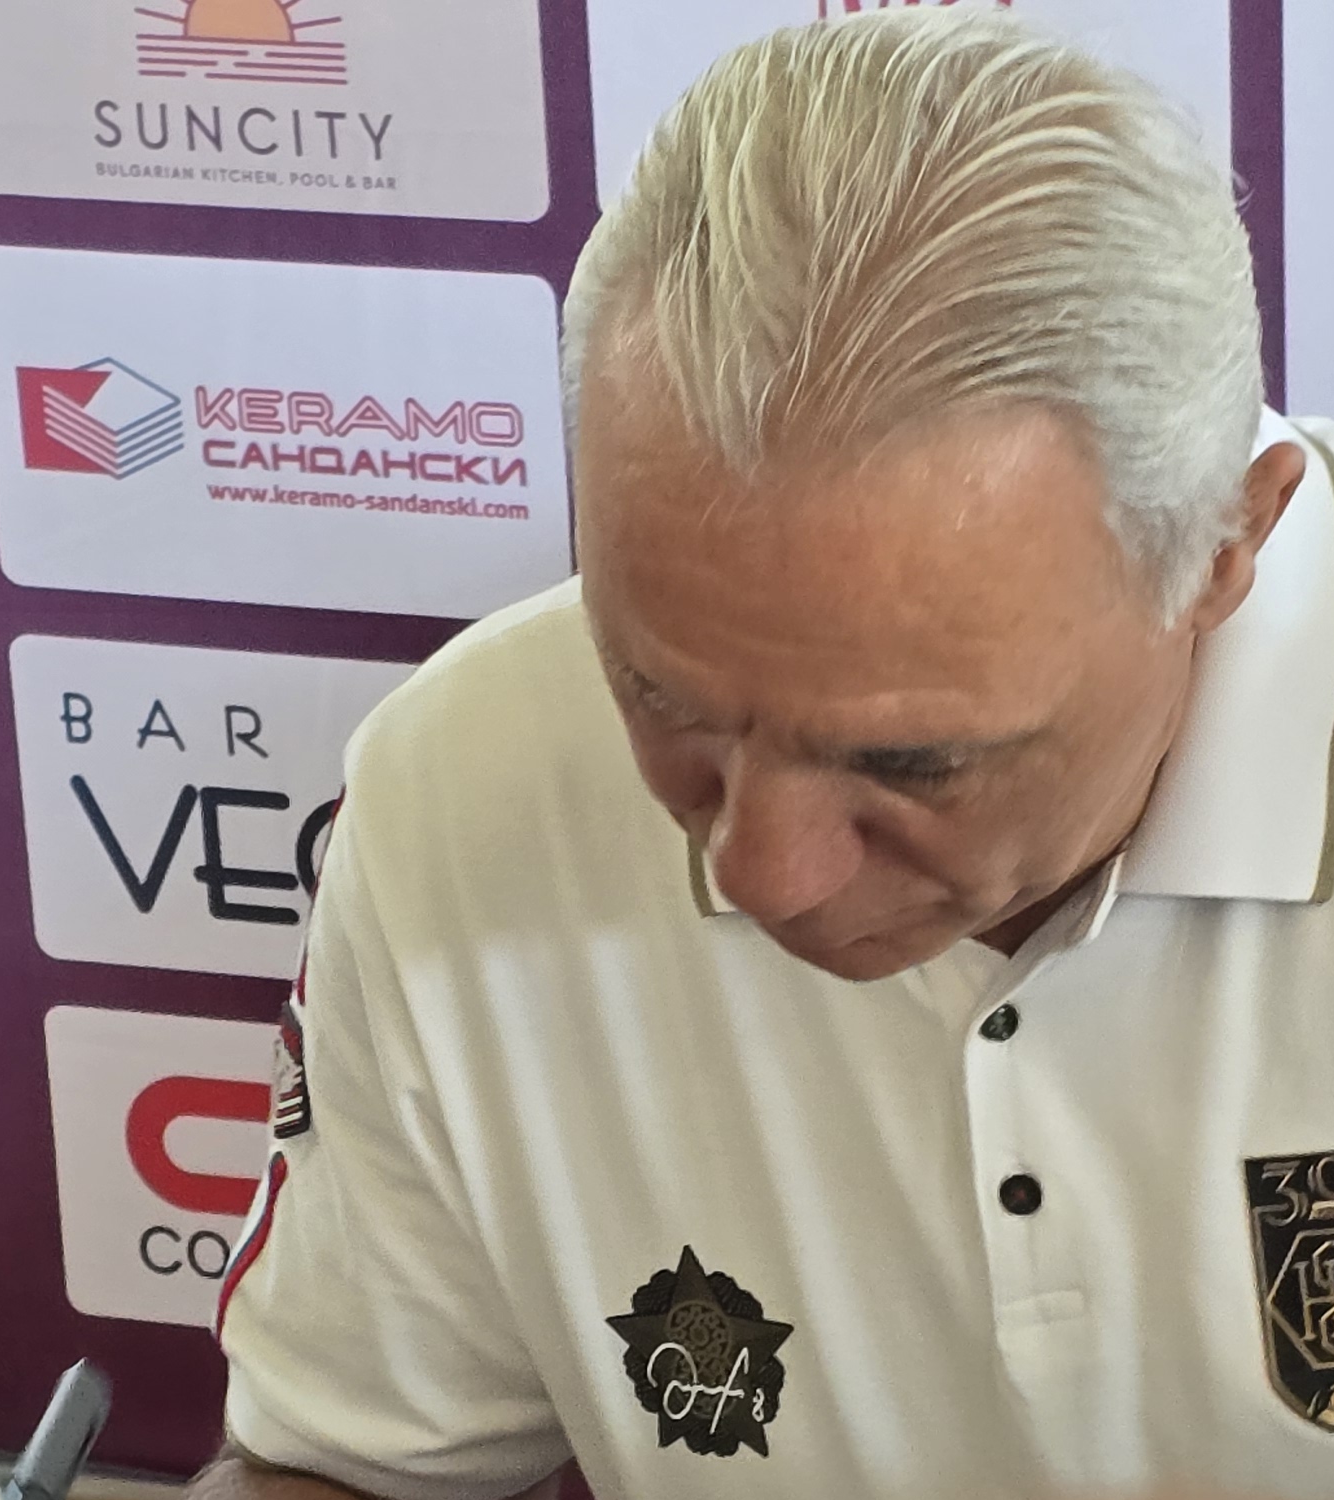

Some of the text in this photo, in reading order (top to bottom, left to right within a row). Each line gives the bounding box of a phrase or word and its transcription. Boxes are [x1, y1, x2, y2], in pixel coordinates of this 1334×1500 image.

[94, 99, 393, 161] SUNCITY
[95, 161, 195, 180] BULGARIAN
[289, 172, 340, 189] POOL
[361, 175, 398, 191] BAR
[195, 384, 524, 447] KERAMO
[202, 439, 529, 487] САНДАНСКИ
[207, 483, 530, 520] www.keramo-sandanski.com
[61, 691, 269, 758] BAR
